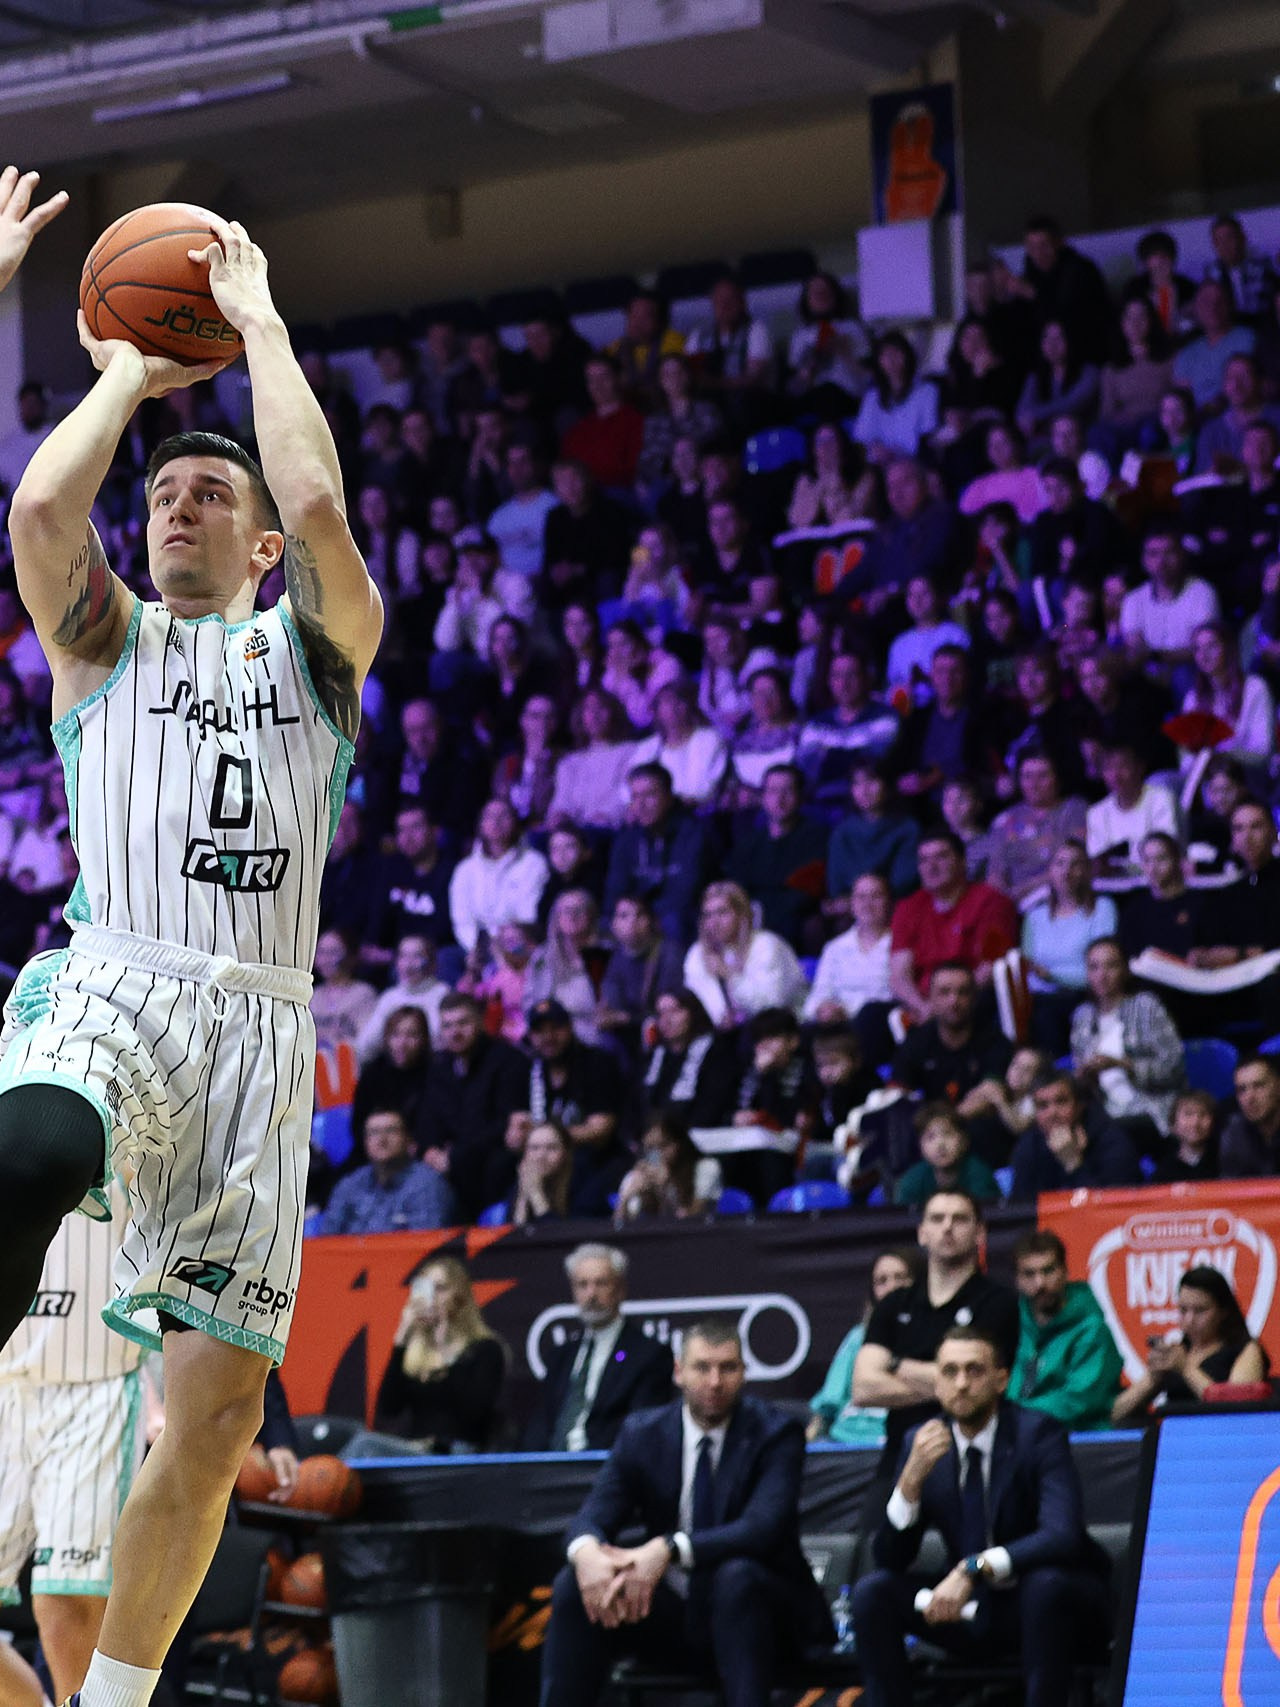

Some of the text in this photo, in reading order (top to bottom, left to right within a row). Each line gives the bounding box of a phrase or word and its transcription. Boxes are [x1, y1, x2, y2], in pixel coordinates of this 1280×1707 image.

[144, 305, 243, 343] JÖGE
[209, 753, 253, 829] 0
[185, 843, 285, 887] PARI
[28, 1292, 73, 1316] RI
[238, 1300, 268, 1316] group
